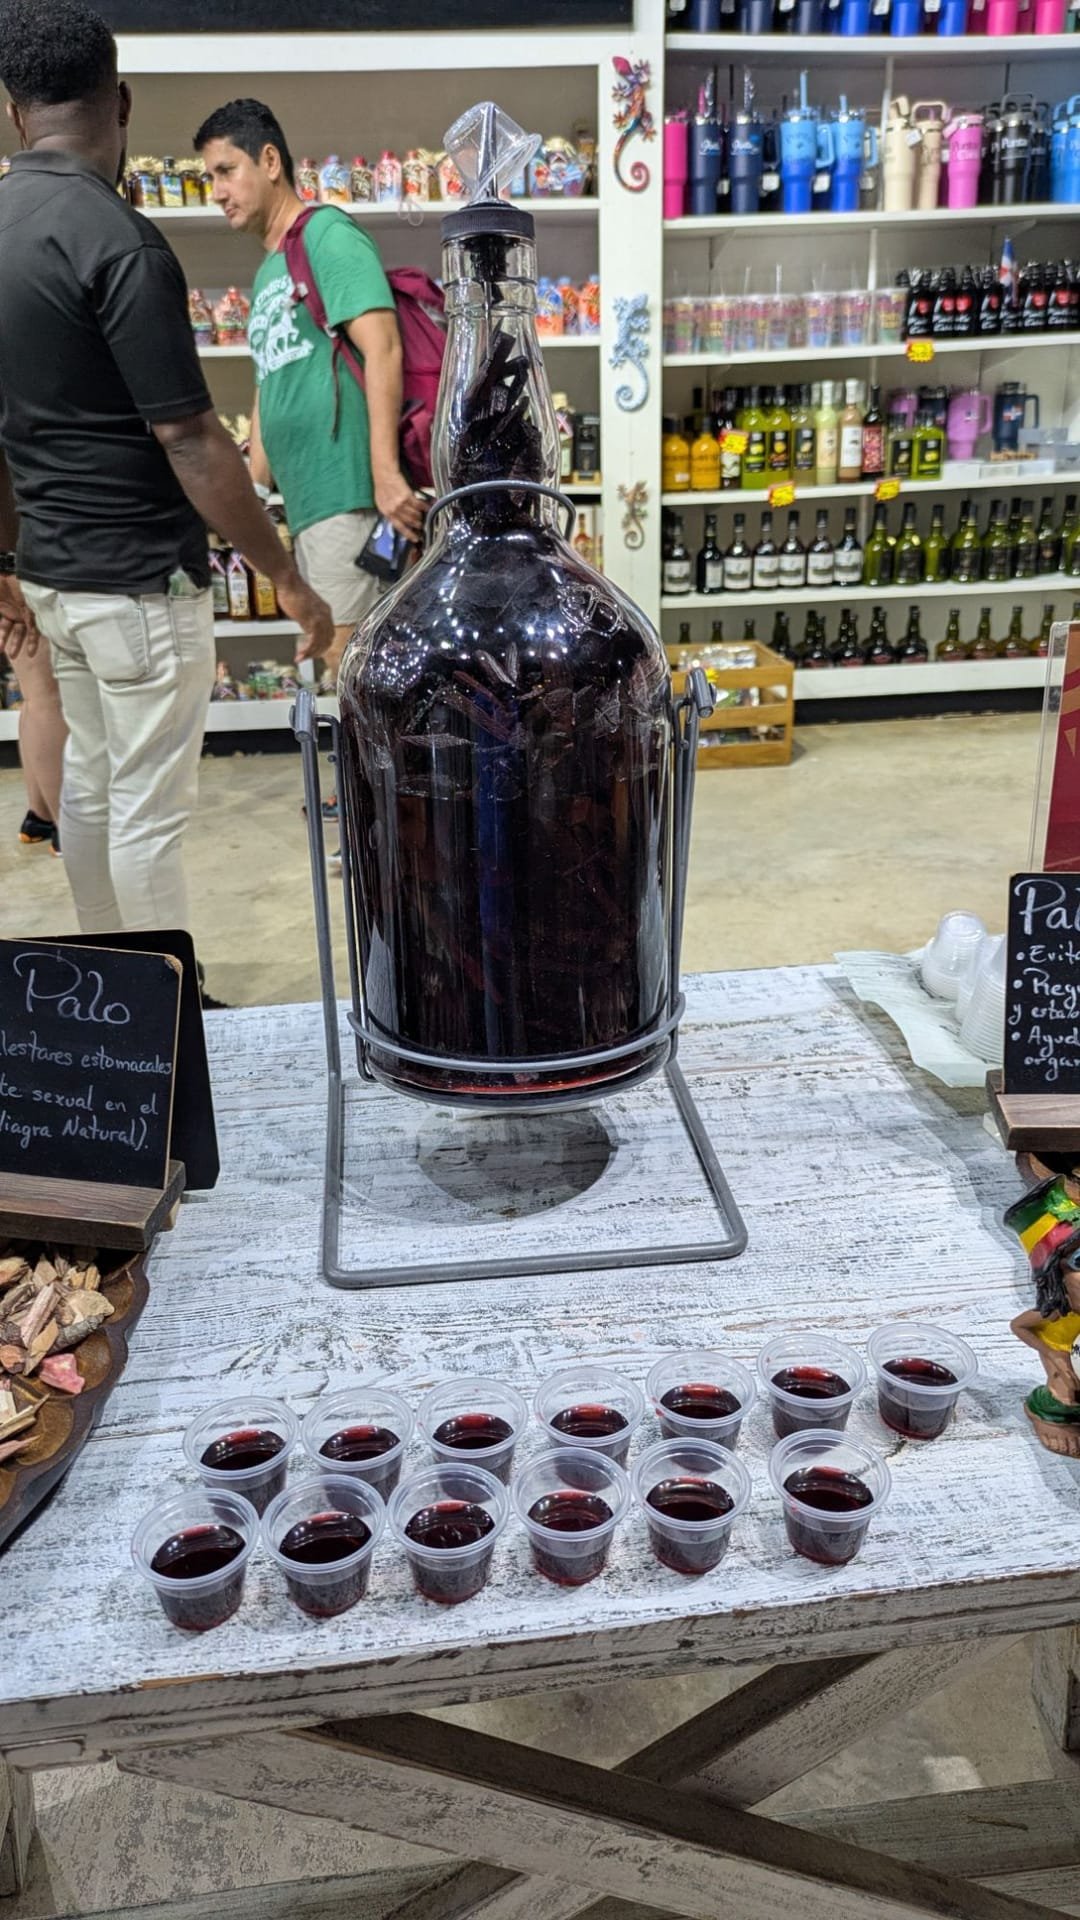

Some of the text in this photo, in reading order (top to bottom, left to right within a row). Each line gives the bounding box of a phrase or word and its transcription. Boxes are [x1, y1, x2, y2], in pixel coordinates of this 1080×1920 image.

[13, 952, 131, 1024] Palo
[1008, 1003, 1022, 1025] y
[81, 1045, 173, 1074] estomacales
[32, 1085, 93, 1111] sexual
[105, 1099, 127, 1113] en
[140, 1093, 159, 1115] el
